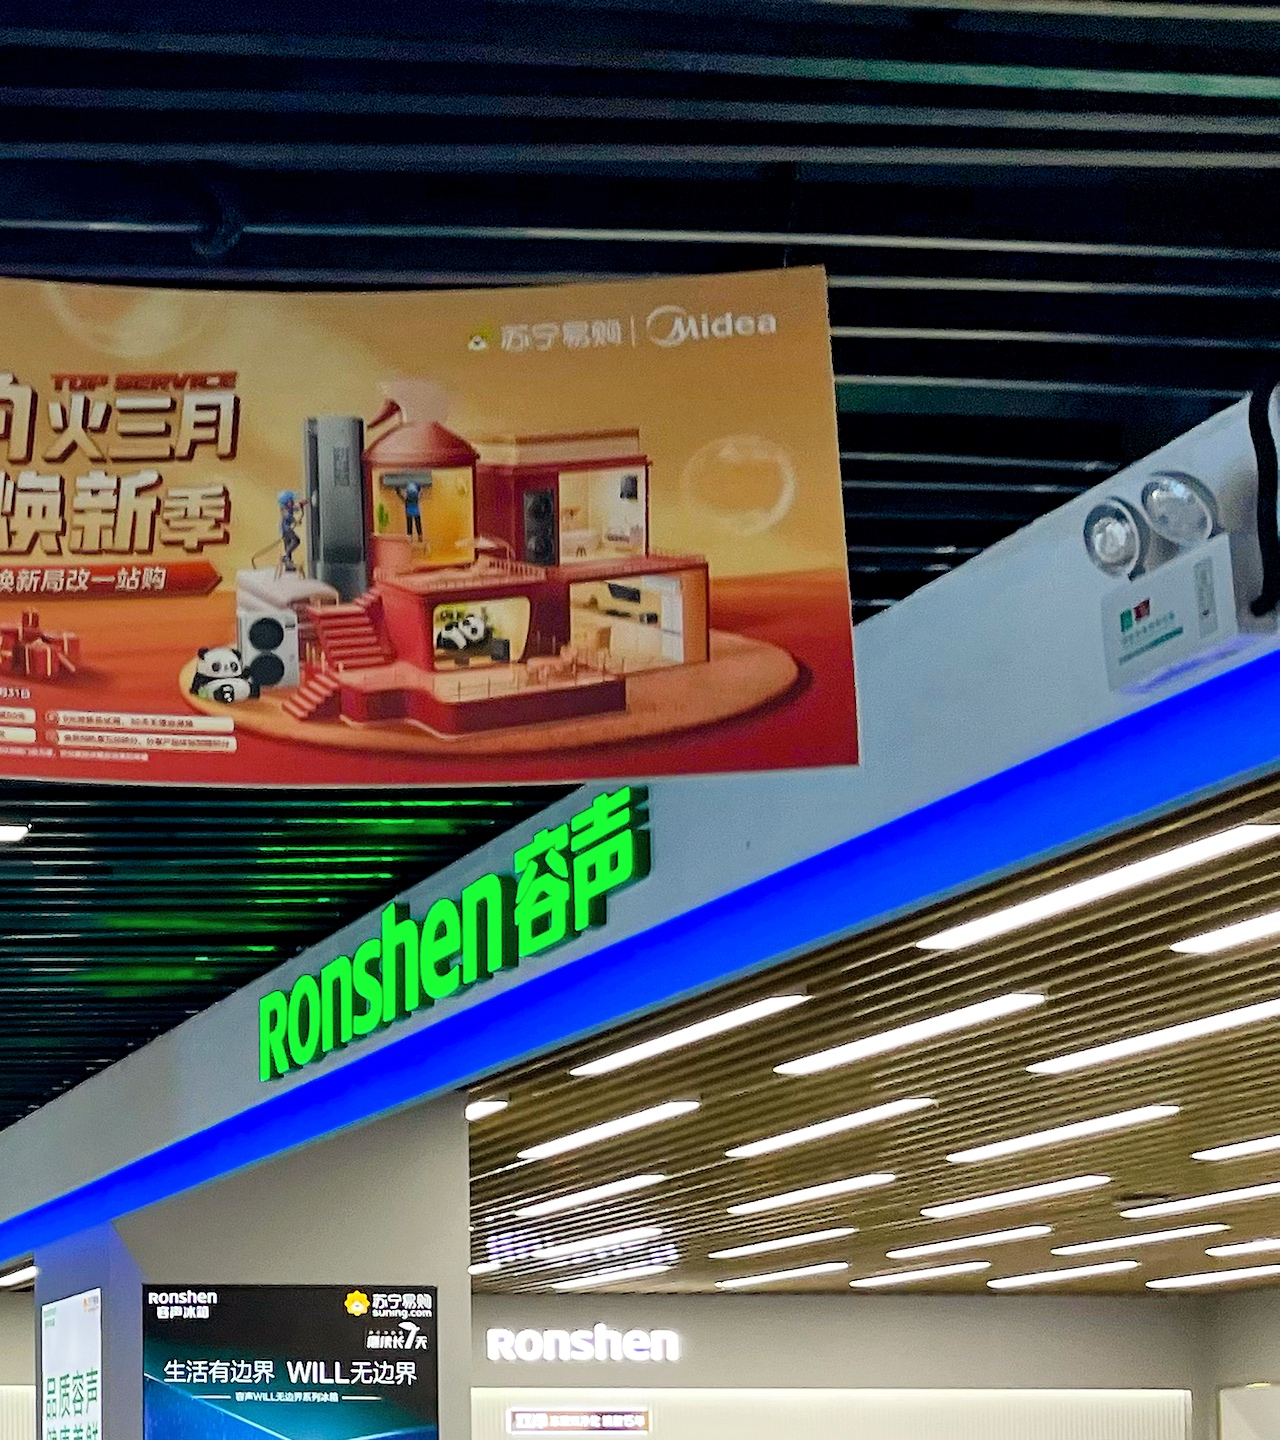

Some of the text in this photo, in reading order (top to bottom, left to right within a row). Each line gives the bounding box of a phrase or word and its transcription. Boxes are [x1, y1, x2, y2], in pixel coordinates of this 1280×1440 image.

[646, 304, 778, 347] Midea
[259, 785, 640, 1083] Ronshen 容声
[148, 1290, 218, 1305] Ronshen
[371, 1293, 433, 1309] 苏宁易购
[371, 1309, 433, 1320] suning.com
[485, 1321, 680, 1362] Ronshen
[163, 1359, 418, 1385] 生活有边界 WILL无边界
[45, 1367, 99, 1420] 品质容声
